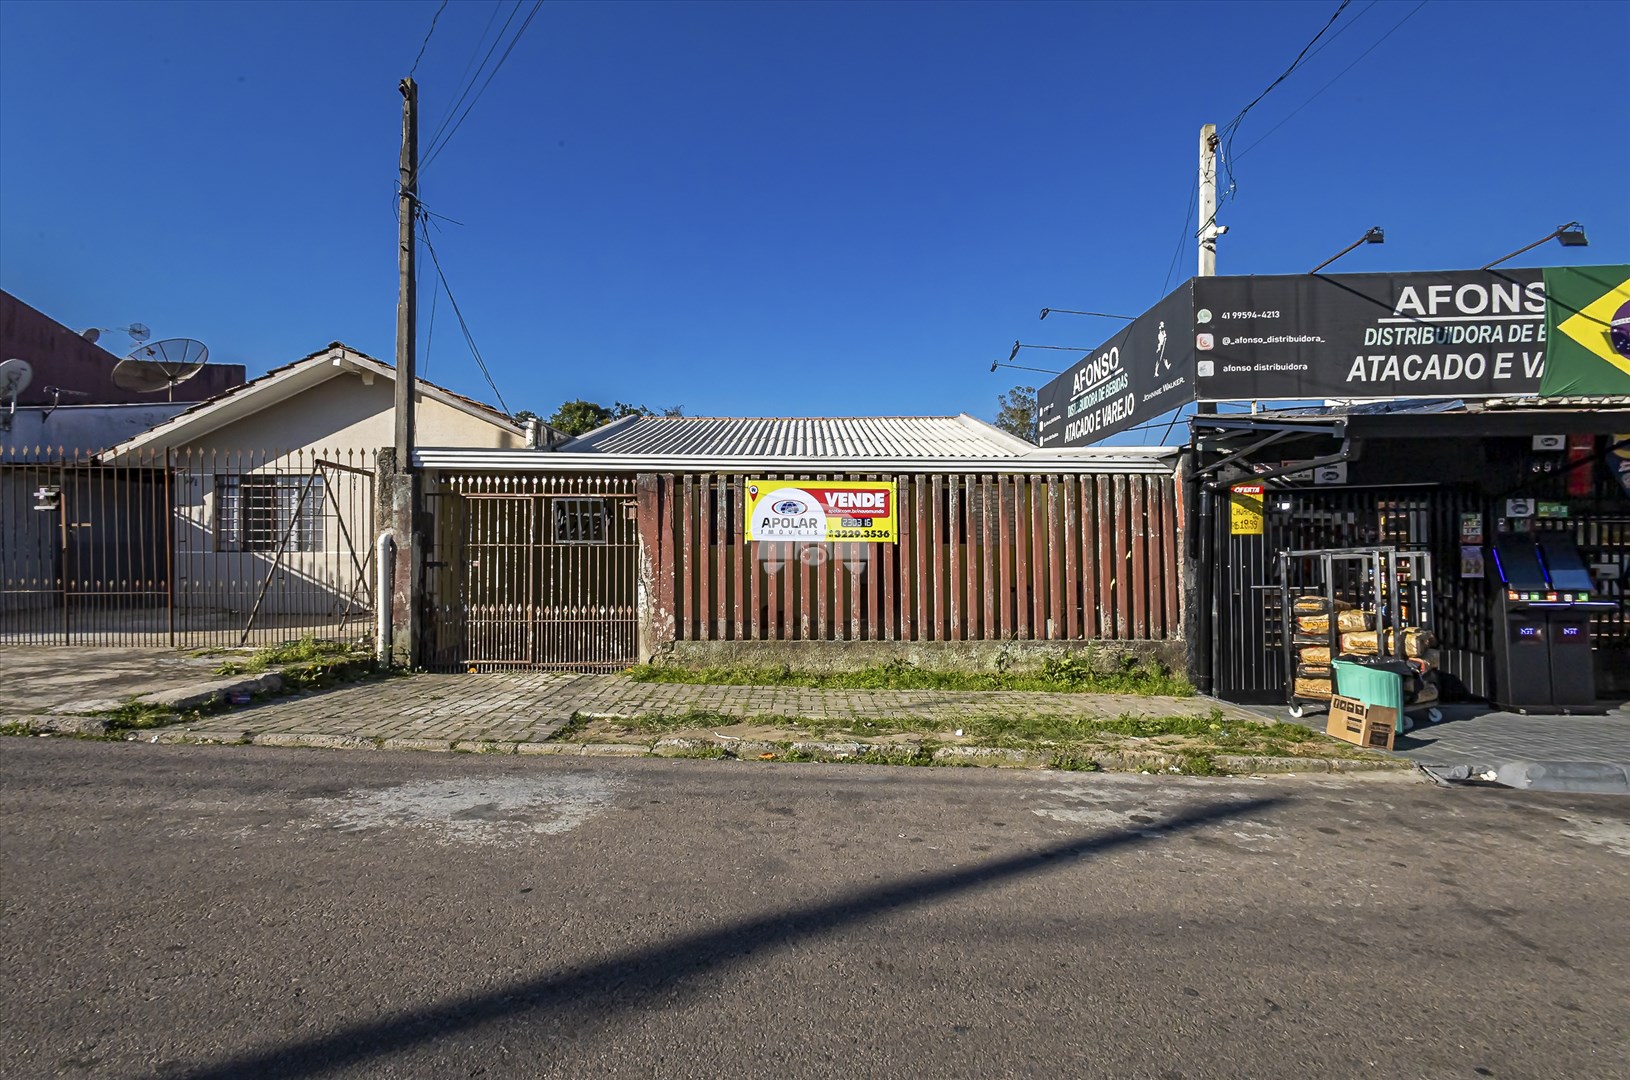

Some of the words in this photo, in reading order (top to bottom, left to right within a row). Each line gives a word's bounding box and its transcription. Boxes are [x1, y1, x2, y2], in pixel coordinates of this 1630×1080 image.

[1232, 311, 1280, 319] 99594-4213
[1222, 335, 1326, 345] @_afonso_distribuidora_
[1364, 325, 1503, 346] DISTRIBUIDORA
[1508, 324, 1534, 343] DE
[1072, 346, 1119, 396] AFONSO
[1222, 364, 1252, 372] afonso
[1253, 363, 1308, 371] distribuidora
[1346, 353, 1486, 382] ATACADO
[1493, 352, 1514, 379] E
[1105, 372, 1129, 398] BEBIDAS
[1064, 414, 1095, 444] ATACADO
[1095, 410, 1101, 431] E
[1101, 392, 1135, 428] VAREJO
[824, 492, 885, 508] VENDE
[761, 517, 818, 528] APOLAR
[834, 529, 890, 538] 3229.3536
